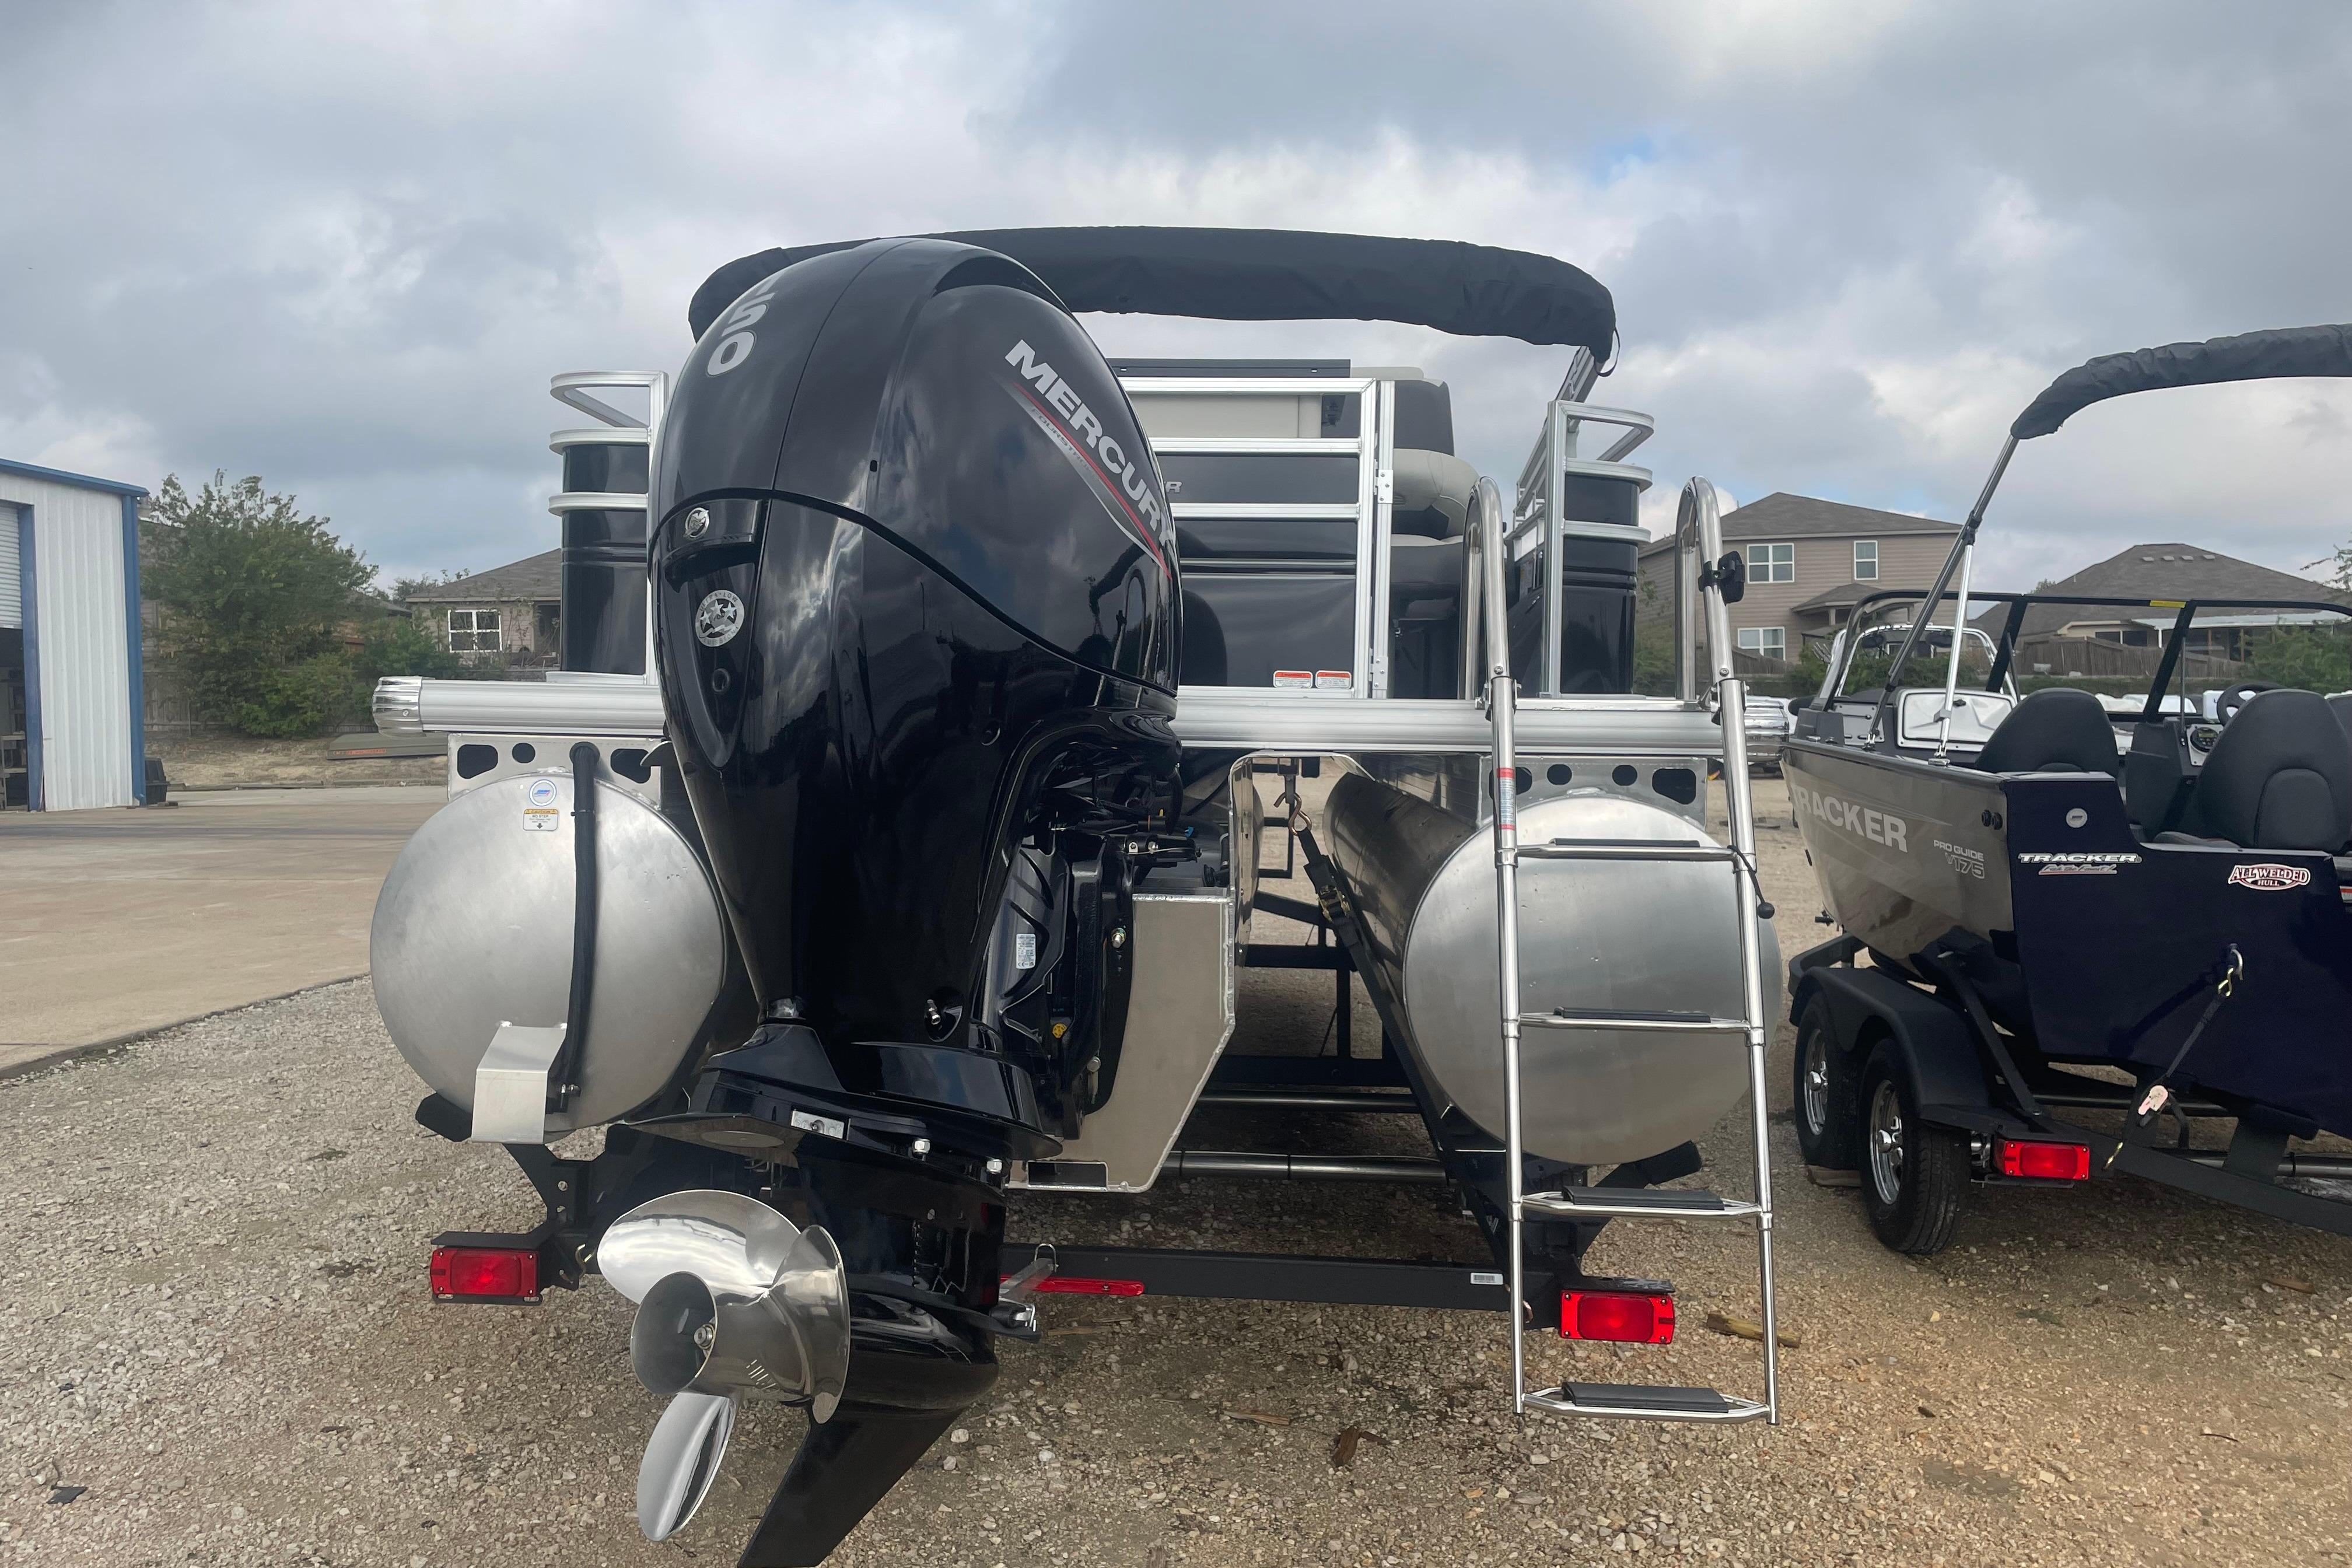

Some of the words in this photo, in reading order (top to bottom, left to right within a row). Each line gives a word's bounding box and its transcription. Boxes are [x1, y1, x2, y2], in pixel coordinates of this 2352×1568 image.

[1005, 340, 1175, 547] MERCURY
[1933, 839, 1952, 852] PRO
[1954, 845, 1985, 862] GUIDE
[2019, 853, 2137, 863] TRACKER
[1945, 852, 1985, 879] V175
[2231, 867, 2256, 880] ALL
[2258, 867, 2308, 883] WELDED
